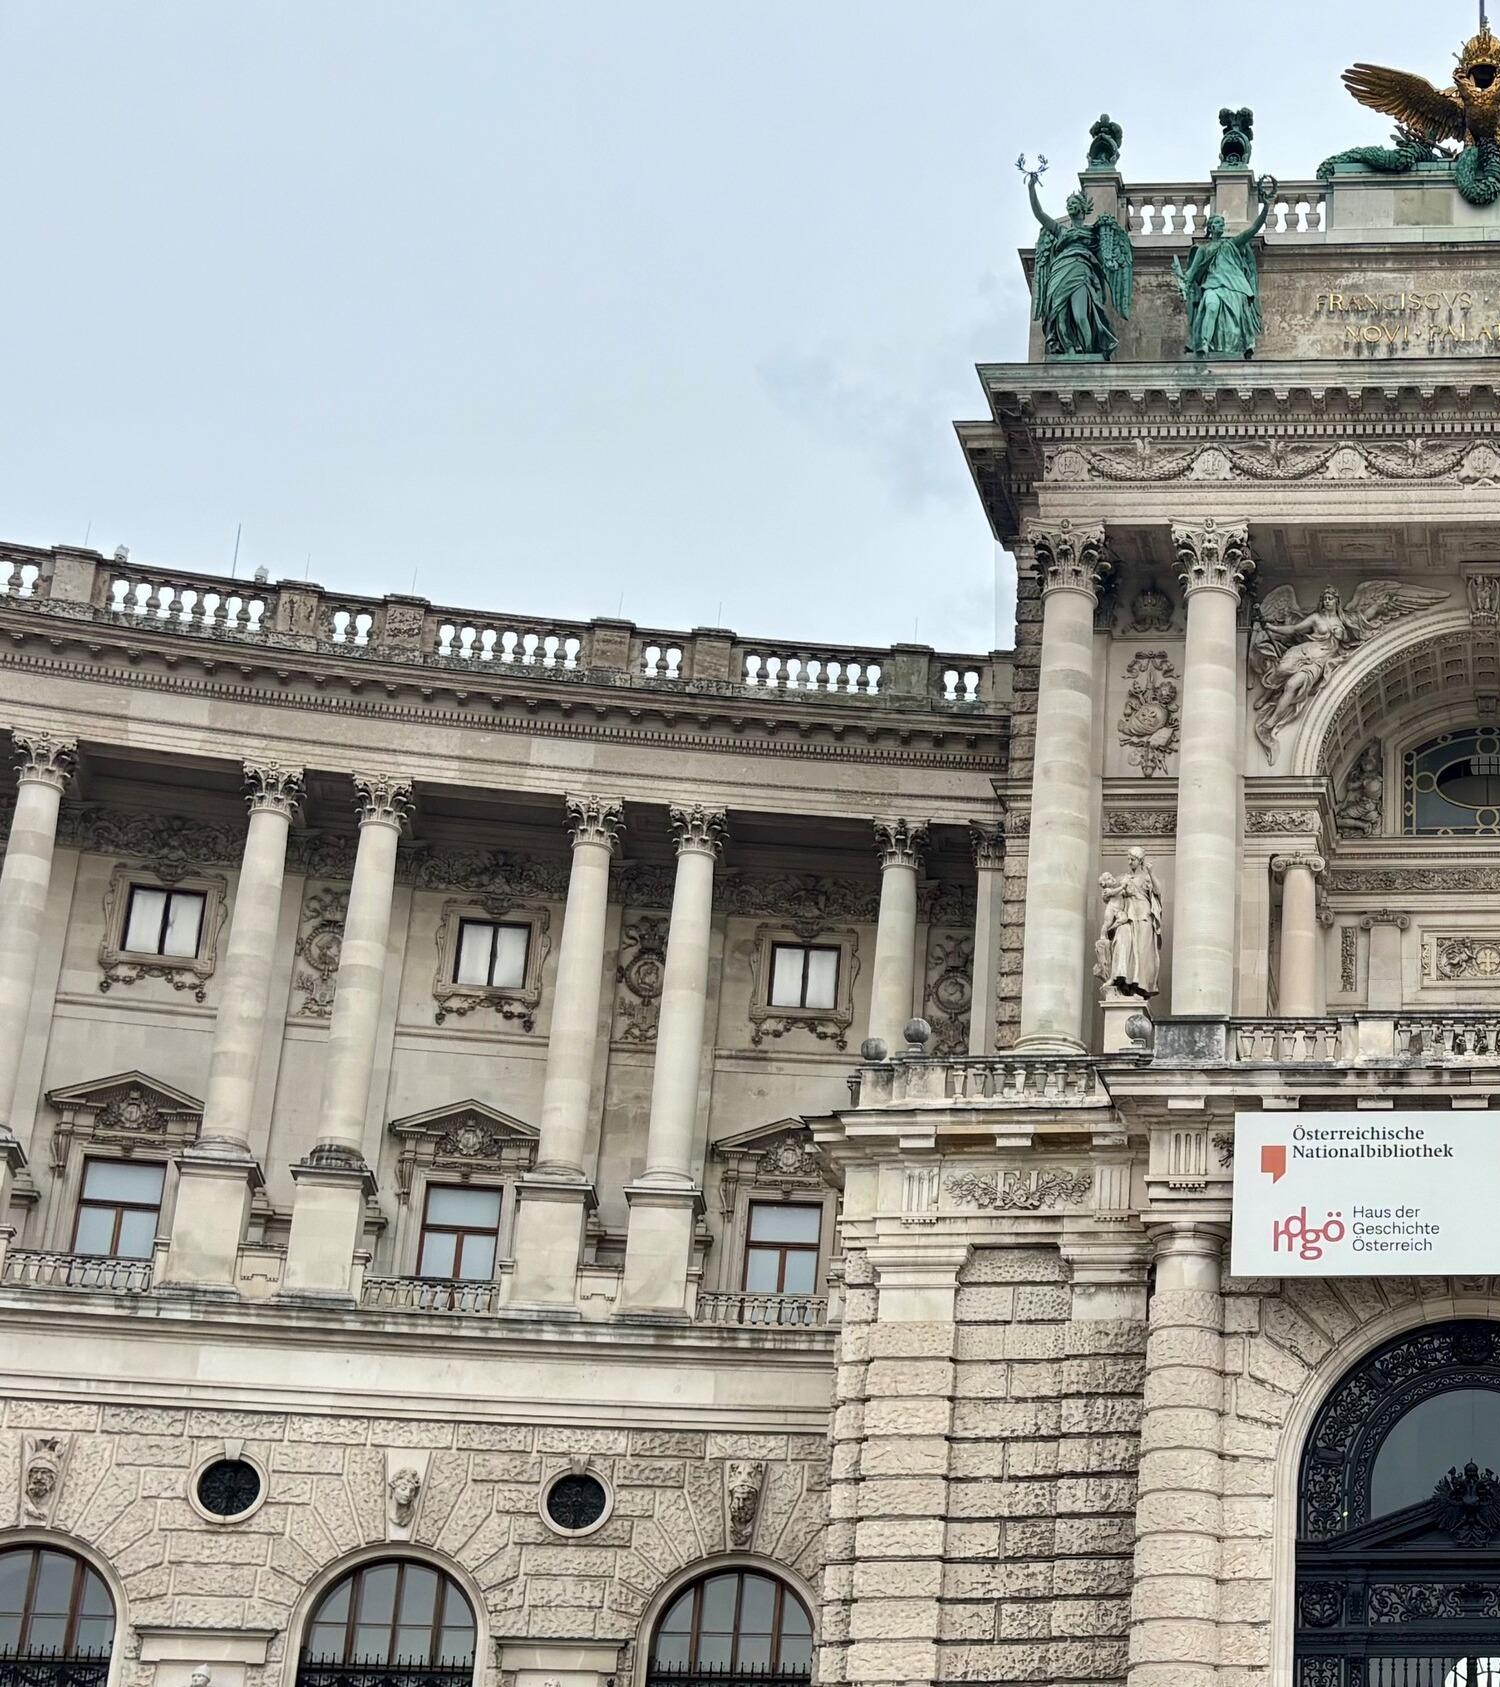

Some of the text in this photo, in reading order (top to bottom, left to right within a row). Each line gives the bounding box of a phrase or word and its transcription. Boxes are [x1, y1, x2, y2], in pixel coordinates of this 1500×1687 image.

[1344, 323, 1409, 343] NOVI
[1293, 1124, 1424, 1140] Österreichische
[1293, 1143, 1453, 1158] Nationalbibliothek
[1354, 1205, 1420, 1218] Haus der
[1353, 1222, 1439, 1235] Geschichte
[1353, 1236, 1432, 1251] Österreich
